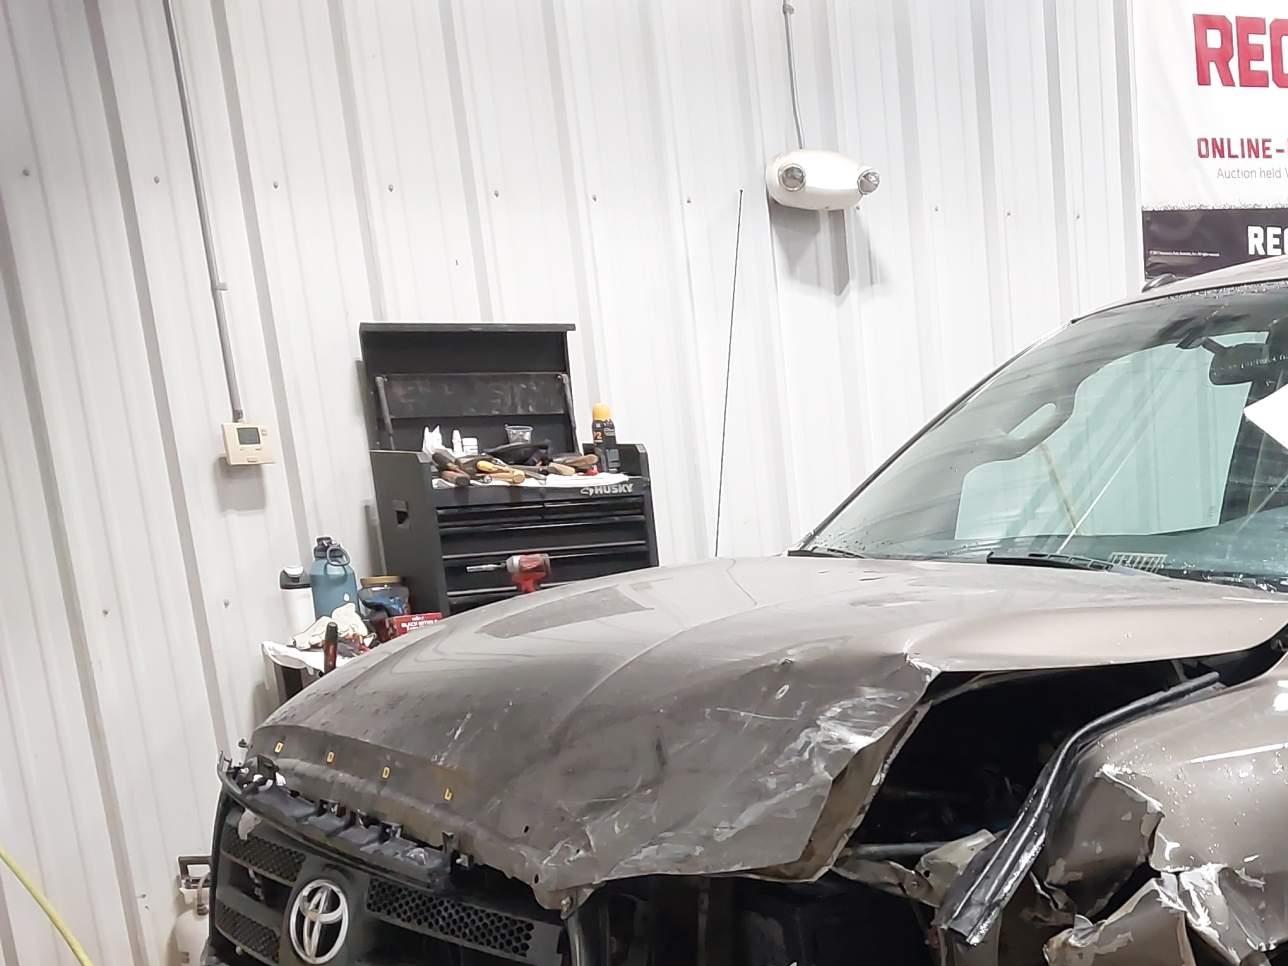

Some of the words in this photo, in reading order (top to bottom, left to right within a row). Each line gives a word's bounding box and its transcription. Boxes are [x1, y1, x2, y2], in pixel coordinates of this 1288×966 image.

[1216, 167, 1257, 179] Auction
[1259, 168, 1282, 179] held
[594, 483, 634, 495] HUSKY
